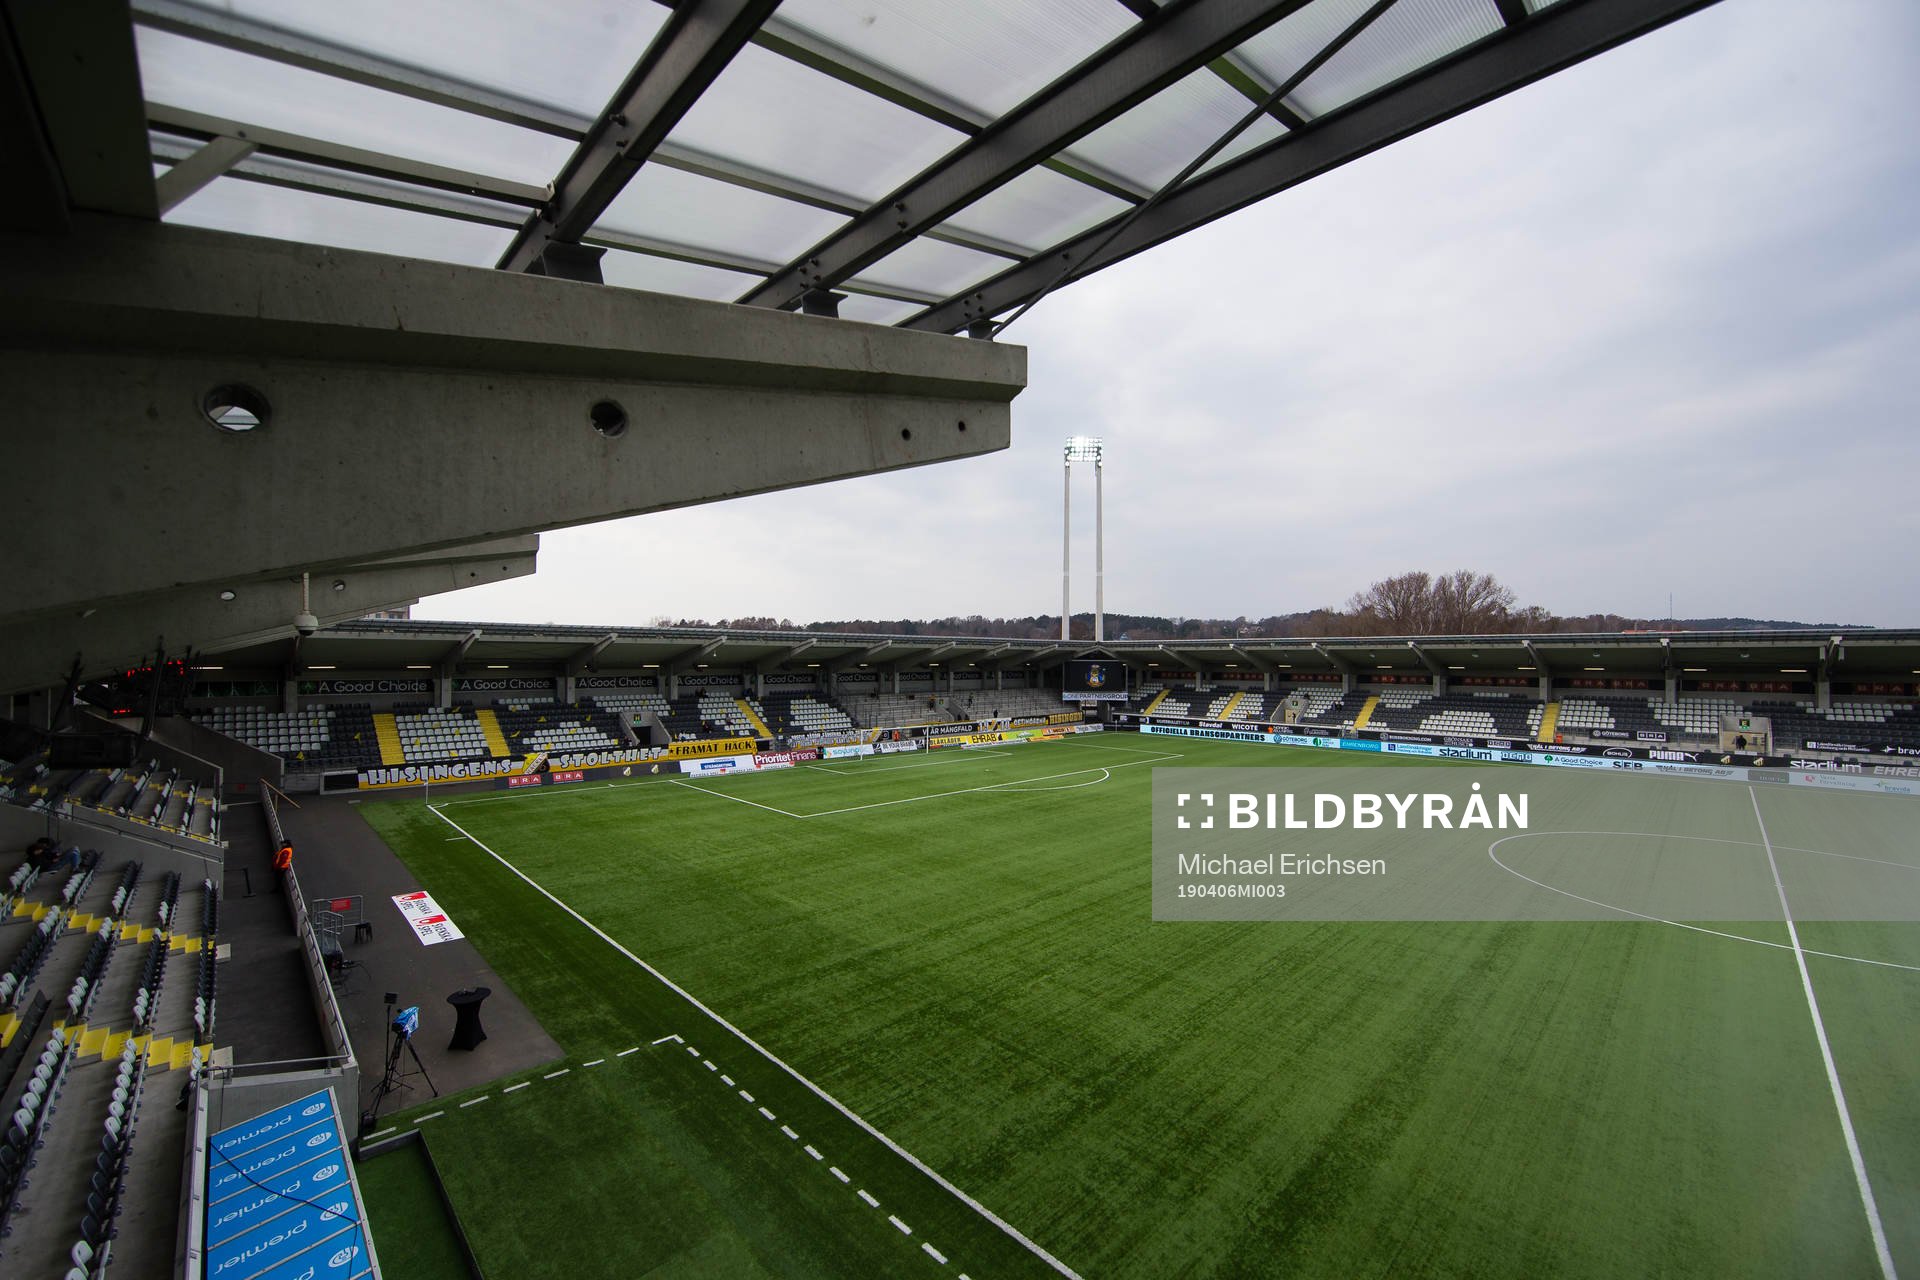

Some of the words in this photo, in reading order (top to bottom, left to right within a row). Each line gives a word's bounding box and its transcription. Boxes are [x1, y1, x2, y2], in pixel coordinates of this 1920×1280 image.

[319, 681, 330, 692] A
[334, 680, 374, 692] Good
[378, 679, 428, 692] Choice
[461, 680, 471, 690] A
[474, 679, 507, 690] Good
[509, 678, 550, 689] Choice
[579, 678, 588, 688] A
[589, 678, 617, 688] Good
[618, 677, 653, 687] Choice
[684, 676, 708, 685] Good
[709, 675, 739, 684] Choice
[940, 724, 973, 735] MÅNGFALD
[1231, 723, 1259, 731] WICOTE
[971, 733, 997, 744] EHRAB
[1150, 726, 1188, 736] OFFICIELLA
[1190, 728, 1266, 742] BRANSCHPARTNERS
[560, 746, 662, 769] STOLTHET
[757, 752, 791, 765] Prioritet
[791, 750, 817, 761] Finans
[1439, 748, 1492, 761] stadium
[1649, 750, 1684, 761] PUMA
[1560, 756, 1578, 764] Good
[1579, 757, 1603, 766] Choice
[1613, 760, 1643, 770] SEB
[1790, 759, 1862, 773] stadium
[367, 759, 512, 785] HISINGENS
[555, 773, 582, 781] BRA
[1873, 765, 1920, 777] EHRE
[511, 776, 540, 785] BRA
[219, 1115, 292, 1151] premier
[216, 1146, 296, 1187] premier
[214, 1180, 301, 1227] premier
[215, 1219, 308, 1275] premier
